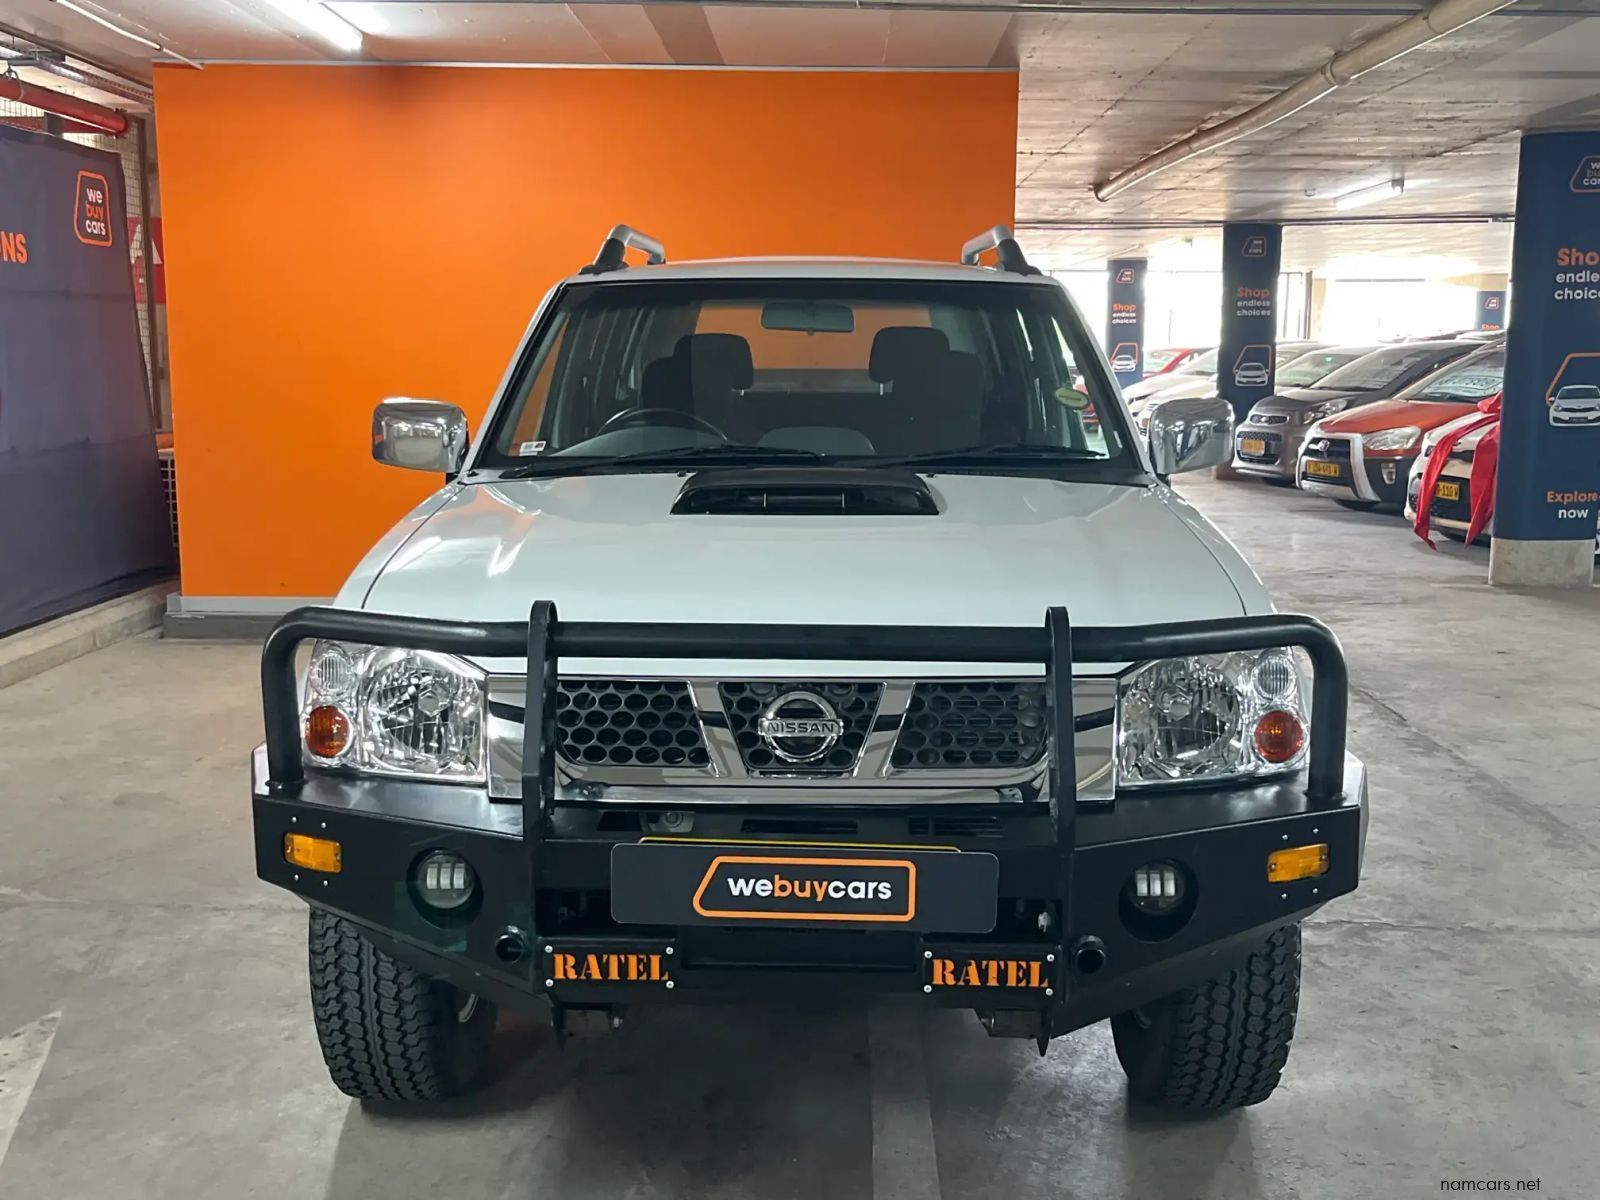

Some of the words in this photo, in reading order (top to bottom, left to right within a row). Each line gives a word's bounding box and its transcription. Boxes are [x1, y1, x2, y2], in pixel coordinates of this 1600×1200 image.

[86, 187, 103, 204] we
[85, 202, 104, 220] buy
[85, 219, 106, 236] cars
[0, 231, 28, 264] NS
[1237, 287, 1270, 299] Shop
[1554, 287, 1600, 300] choic
[1112, 303, 1137, 313] Shop
[1236, 299, 1271, 307] endless
[1236, 309, 1271, 317] choices
[1546, 490, 1597, 505] Explore
[1558, 508, 1589, 519] now
[767, 722, 834, 734] NISSAN
[726, 874, 893, 903] webuycars
[552, 952, 670, 982] RATEL
[931, 957, 1049, 989] RATEL
